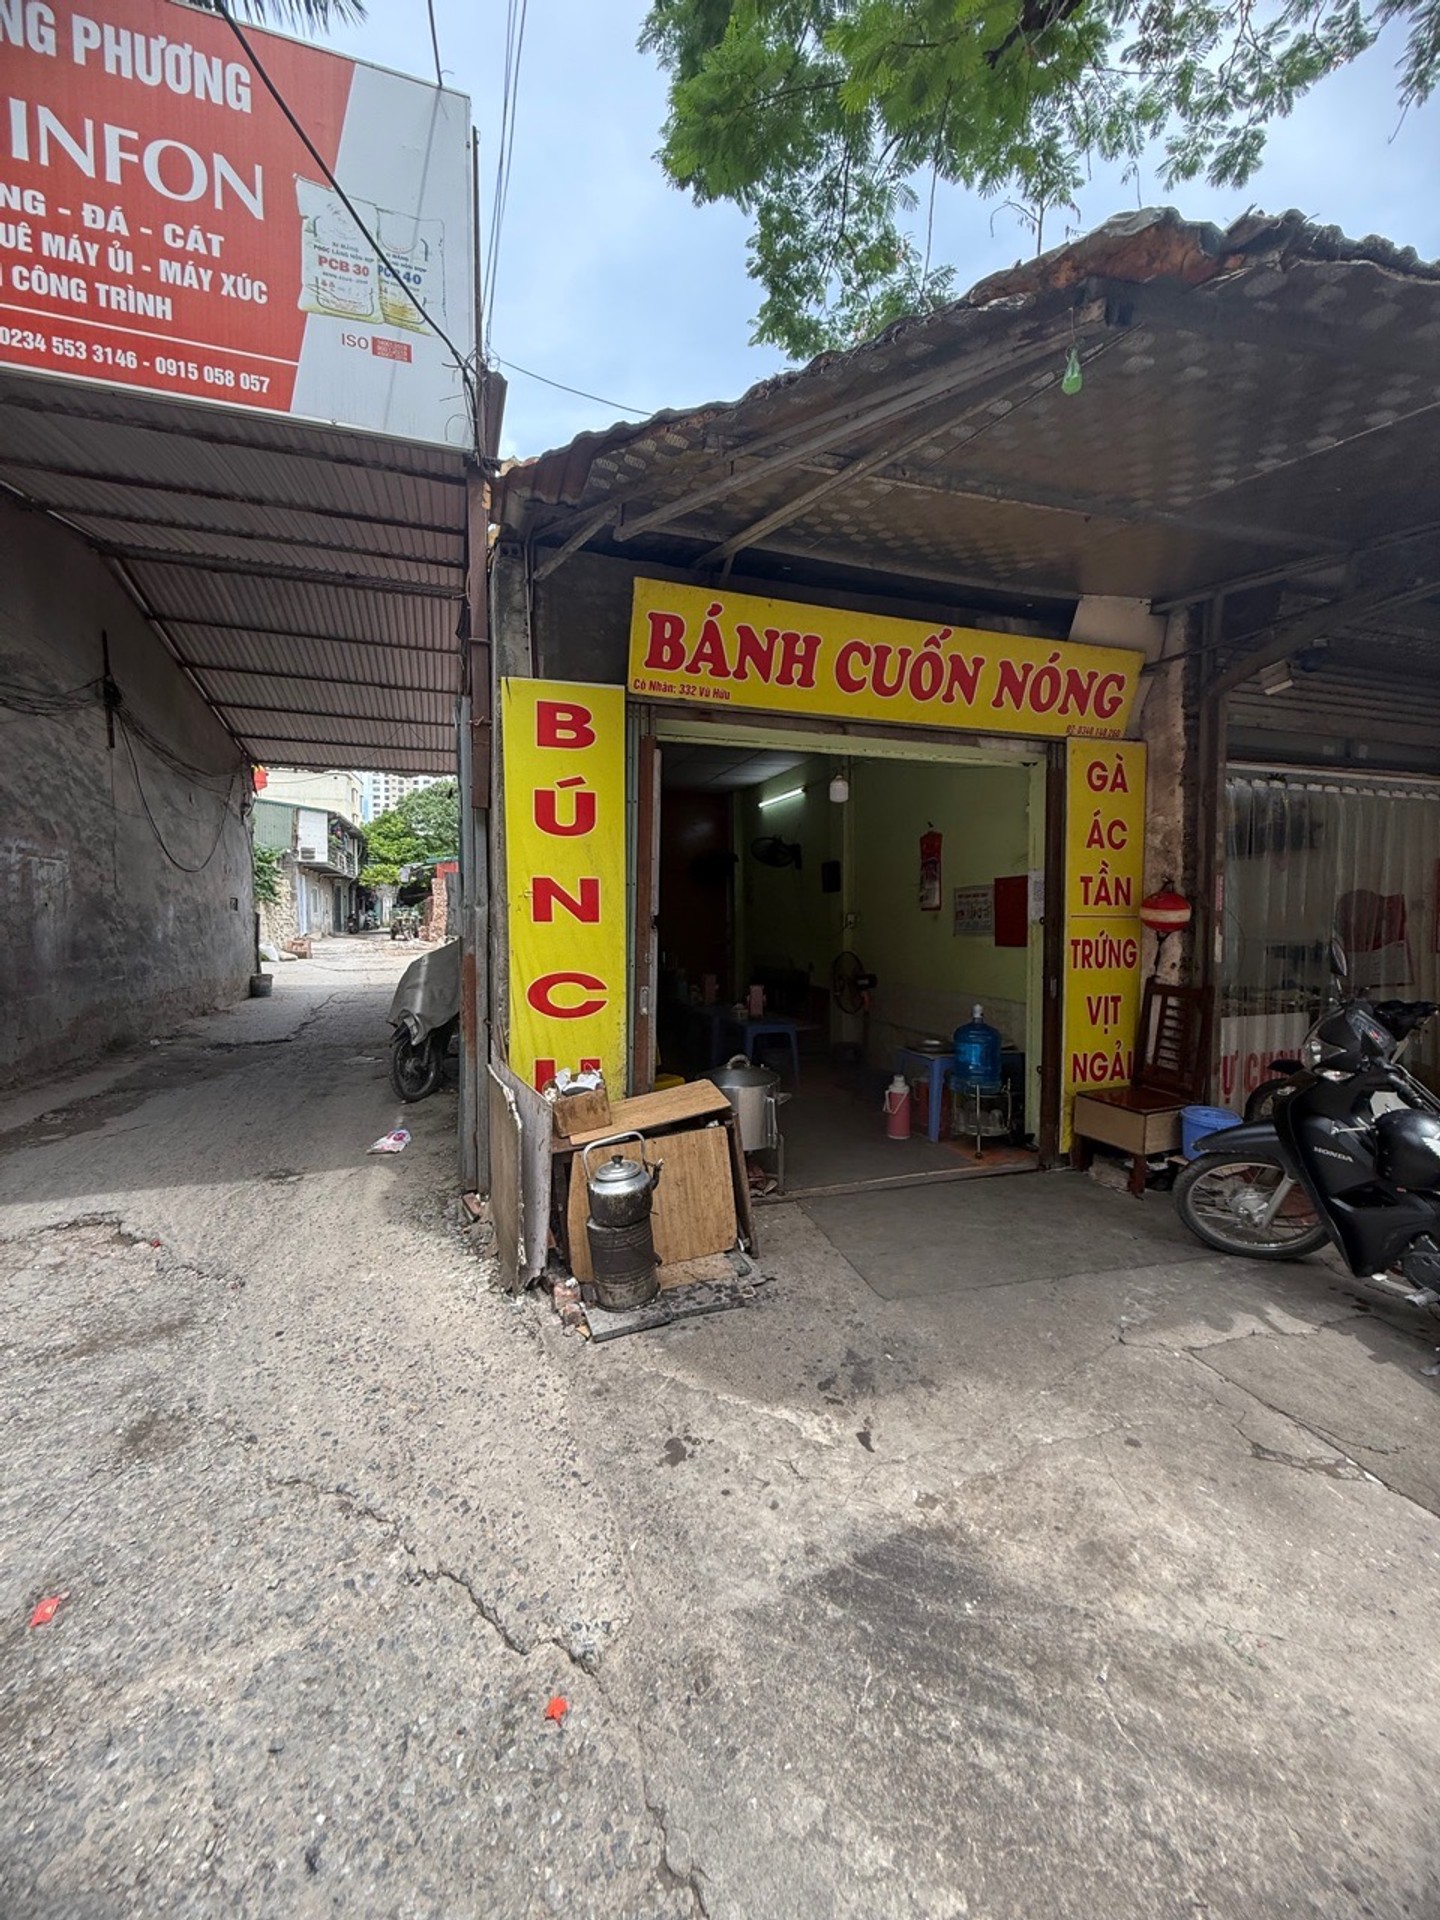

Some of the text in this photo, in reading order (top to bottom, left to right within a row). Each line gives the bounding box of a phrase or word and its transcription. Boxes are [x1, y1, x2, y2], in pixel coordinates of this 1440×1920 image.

[72, 13, 252, 113] PHƯƠNG
[9, 97, 264, 220] INFON
[0, 183, 46, 217] NG
[82, 202, 130, 236] ĐÁ
[163, 223, 225, 258] CÁT
[0, 221, 33, 253] UÊ
[41, 233, 100, 267] MÁY
[108, 240, 133, 275] ỦI
[159, 258, 213, 292] MÁY
[220, 272, 268, 304] XÚC
[318, 255, 370, 277] PCB 30
[377, 264, 400, 277] PC
[403, 271, 422, 285] 40
[11, 265, 87, 303] CÔNG
[95, 283, 172, 321] TRÌNH
[0, 326, 47, 352] 0234
[52, 336, 87, 359] 553
[92, 344, 137, 368] 3146
[155, 356, 199, 380] 0915
[203, 365, 235, 387] 058
[239, 373, 271, 393] 057
[341, 333, 369, 350] ISO
[644, 603, 1127, 719] BÁNH CUỐN NÓNG
[679, 684, 697, 696] 332
[1086, 754, 1129, 794] GÀ
[1086, 809, 1128, 850] ÁC
[1080, 860, 1131, 907] TẦN
[1070, 931, 1137, 969] TRỨNG
[1087, 995, 1122, 1034] VỊT
[1072, 1040, 1132, 1083] NGẢI
[1313, 1145, 1354, 1163] HONDA
